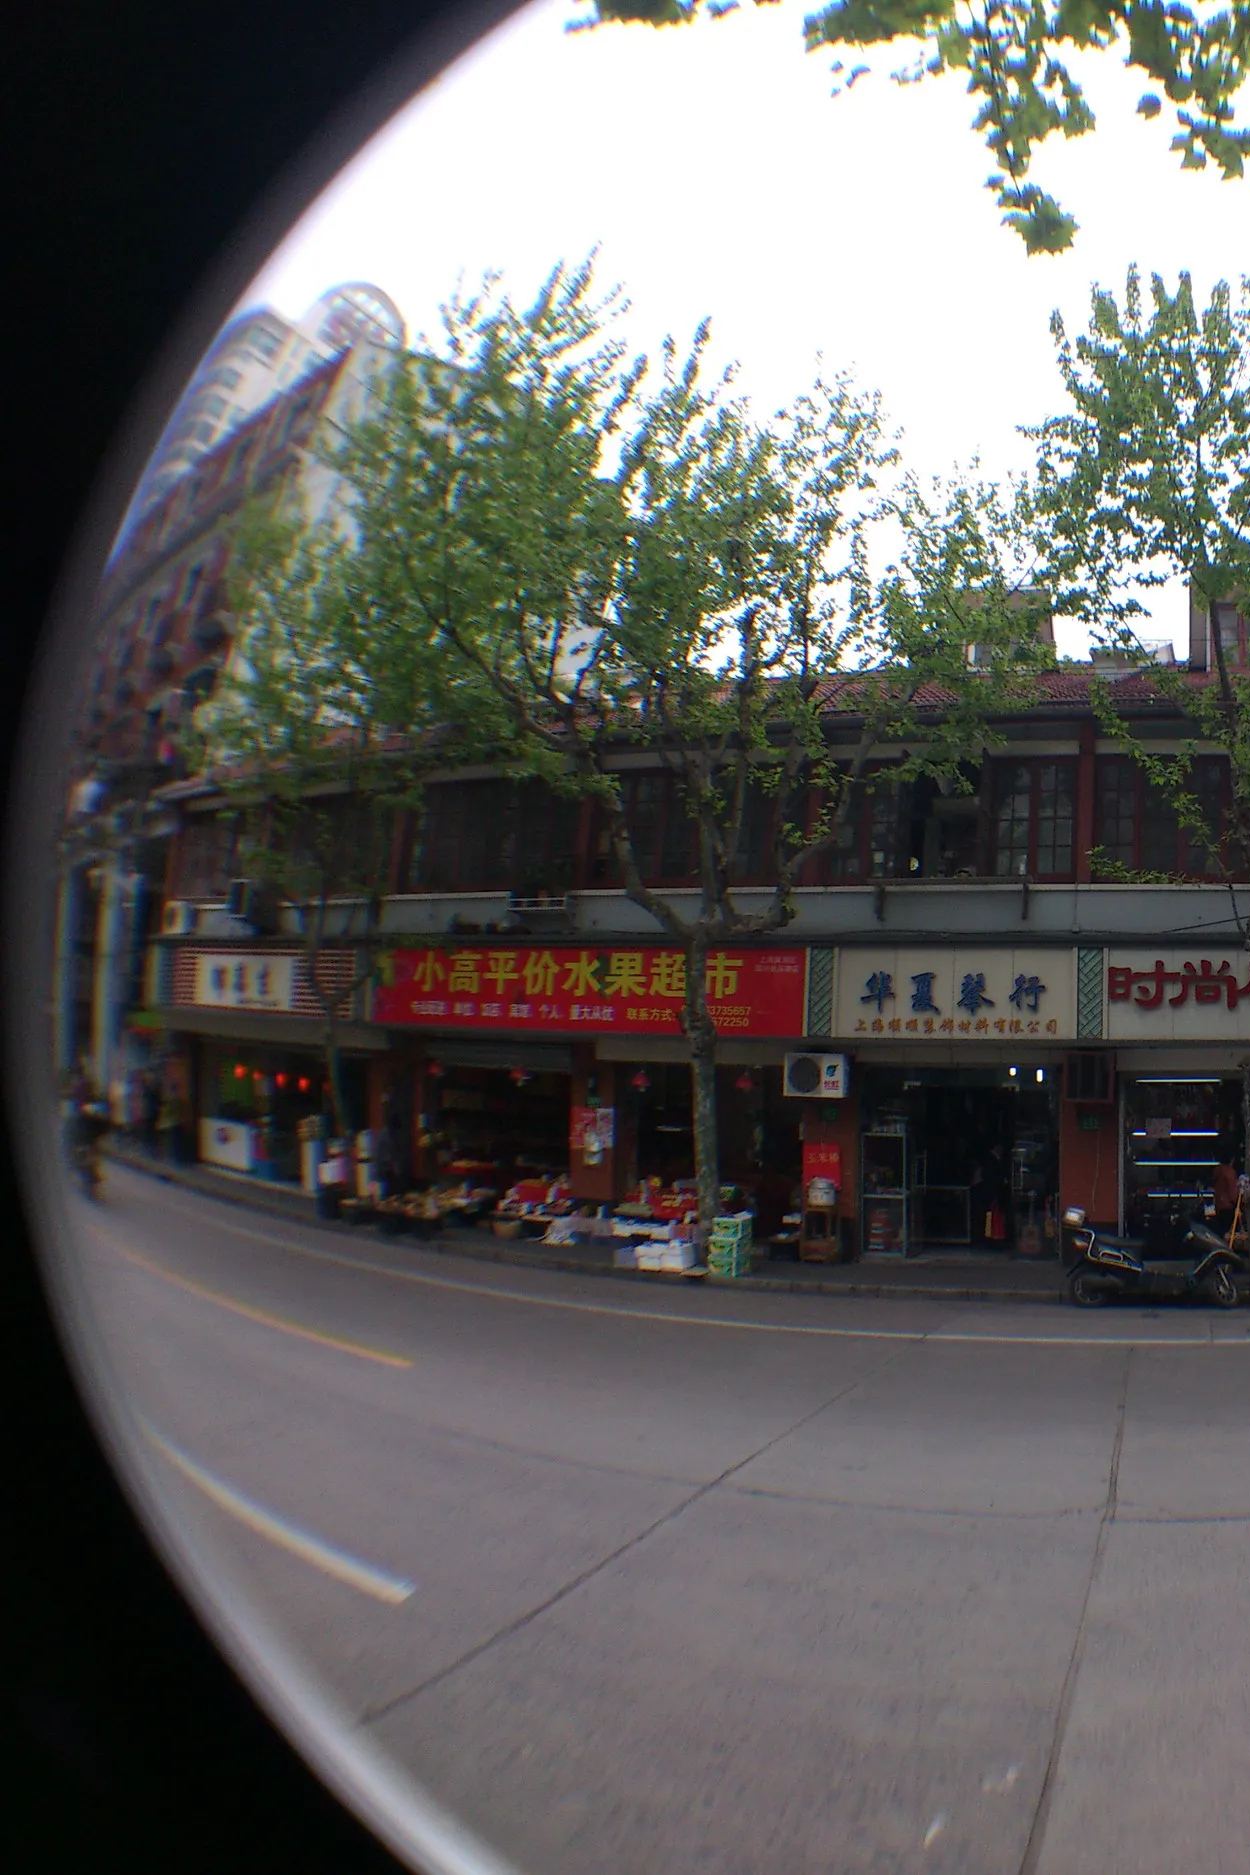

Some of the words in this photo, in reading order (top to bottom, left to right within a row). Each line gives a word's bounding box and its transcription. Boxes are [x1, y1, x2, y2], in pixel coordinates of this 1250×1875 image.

[413, 951, 744, 998] 小高平价水果超市
[860, 971, 1047, 1016] 华夏琴行
